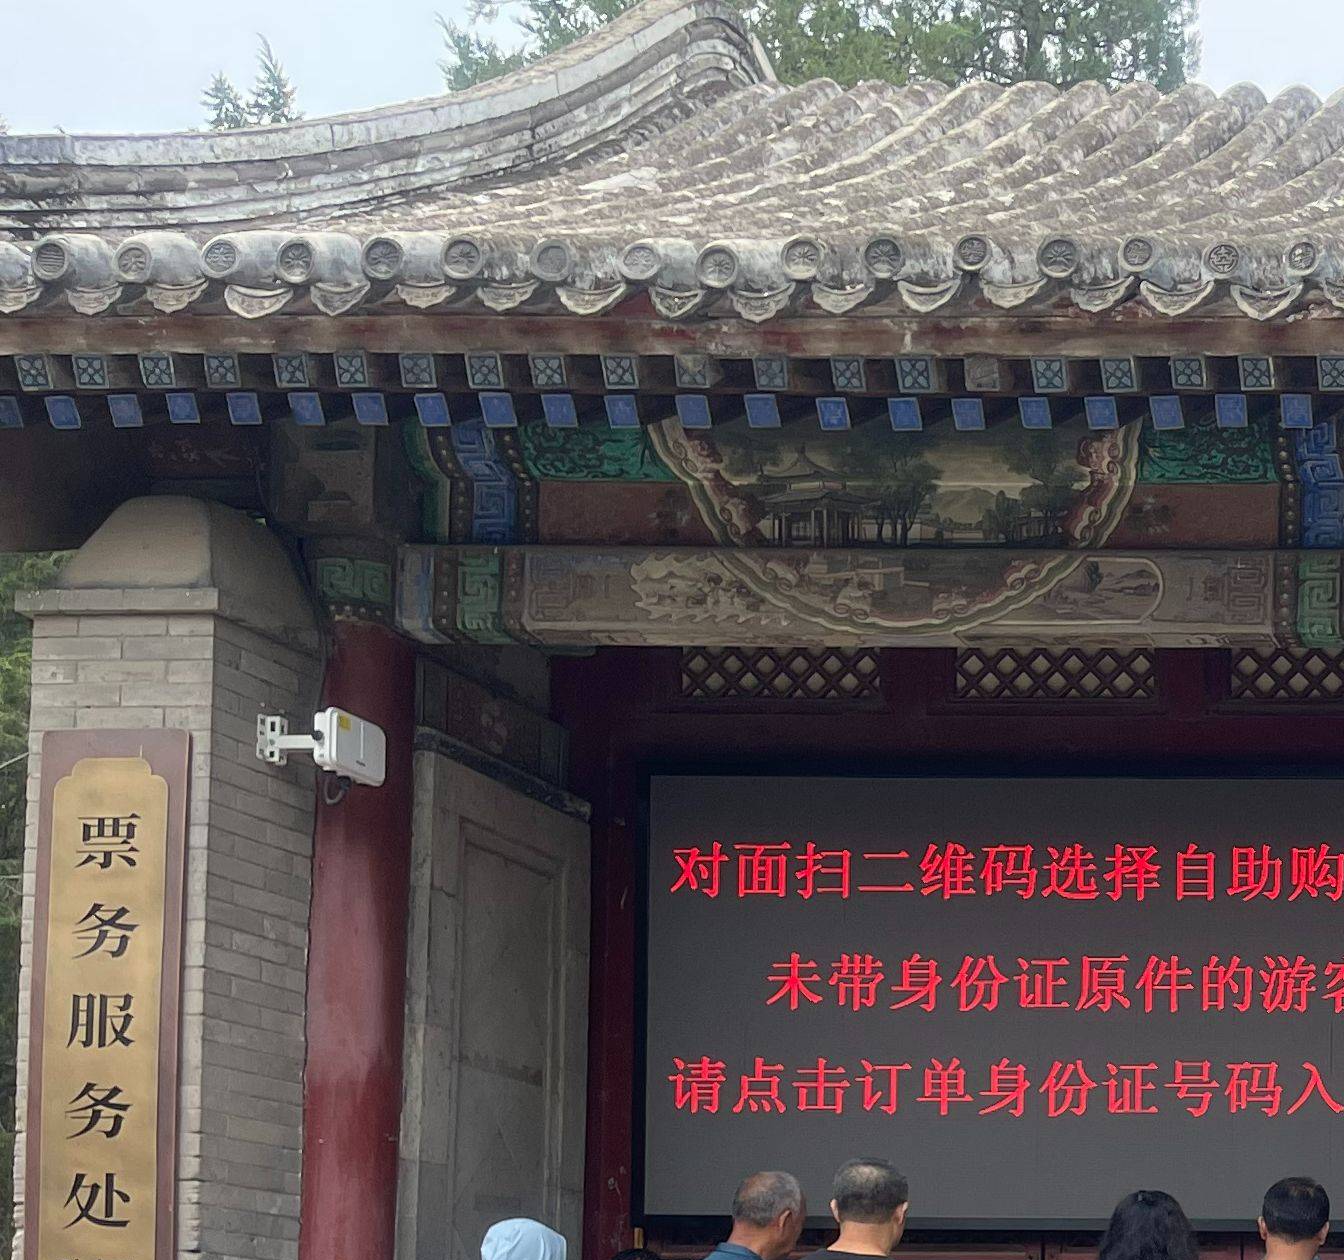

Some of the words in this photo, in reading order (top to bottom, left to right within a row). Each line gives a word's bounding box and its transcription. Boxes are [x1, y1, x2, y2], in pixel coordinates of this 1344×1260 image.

[64, 812, 141, 1231] 票务服务处
